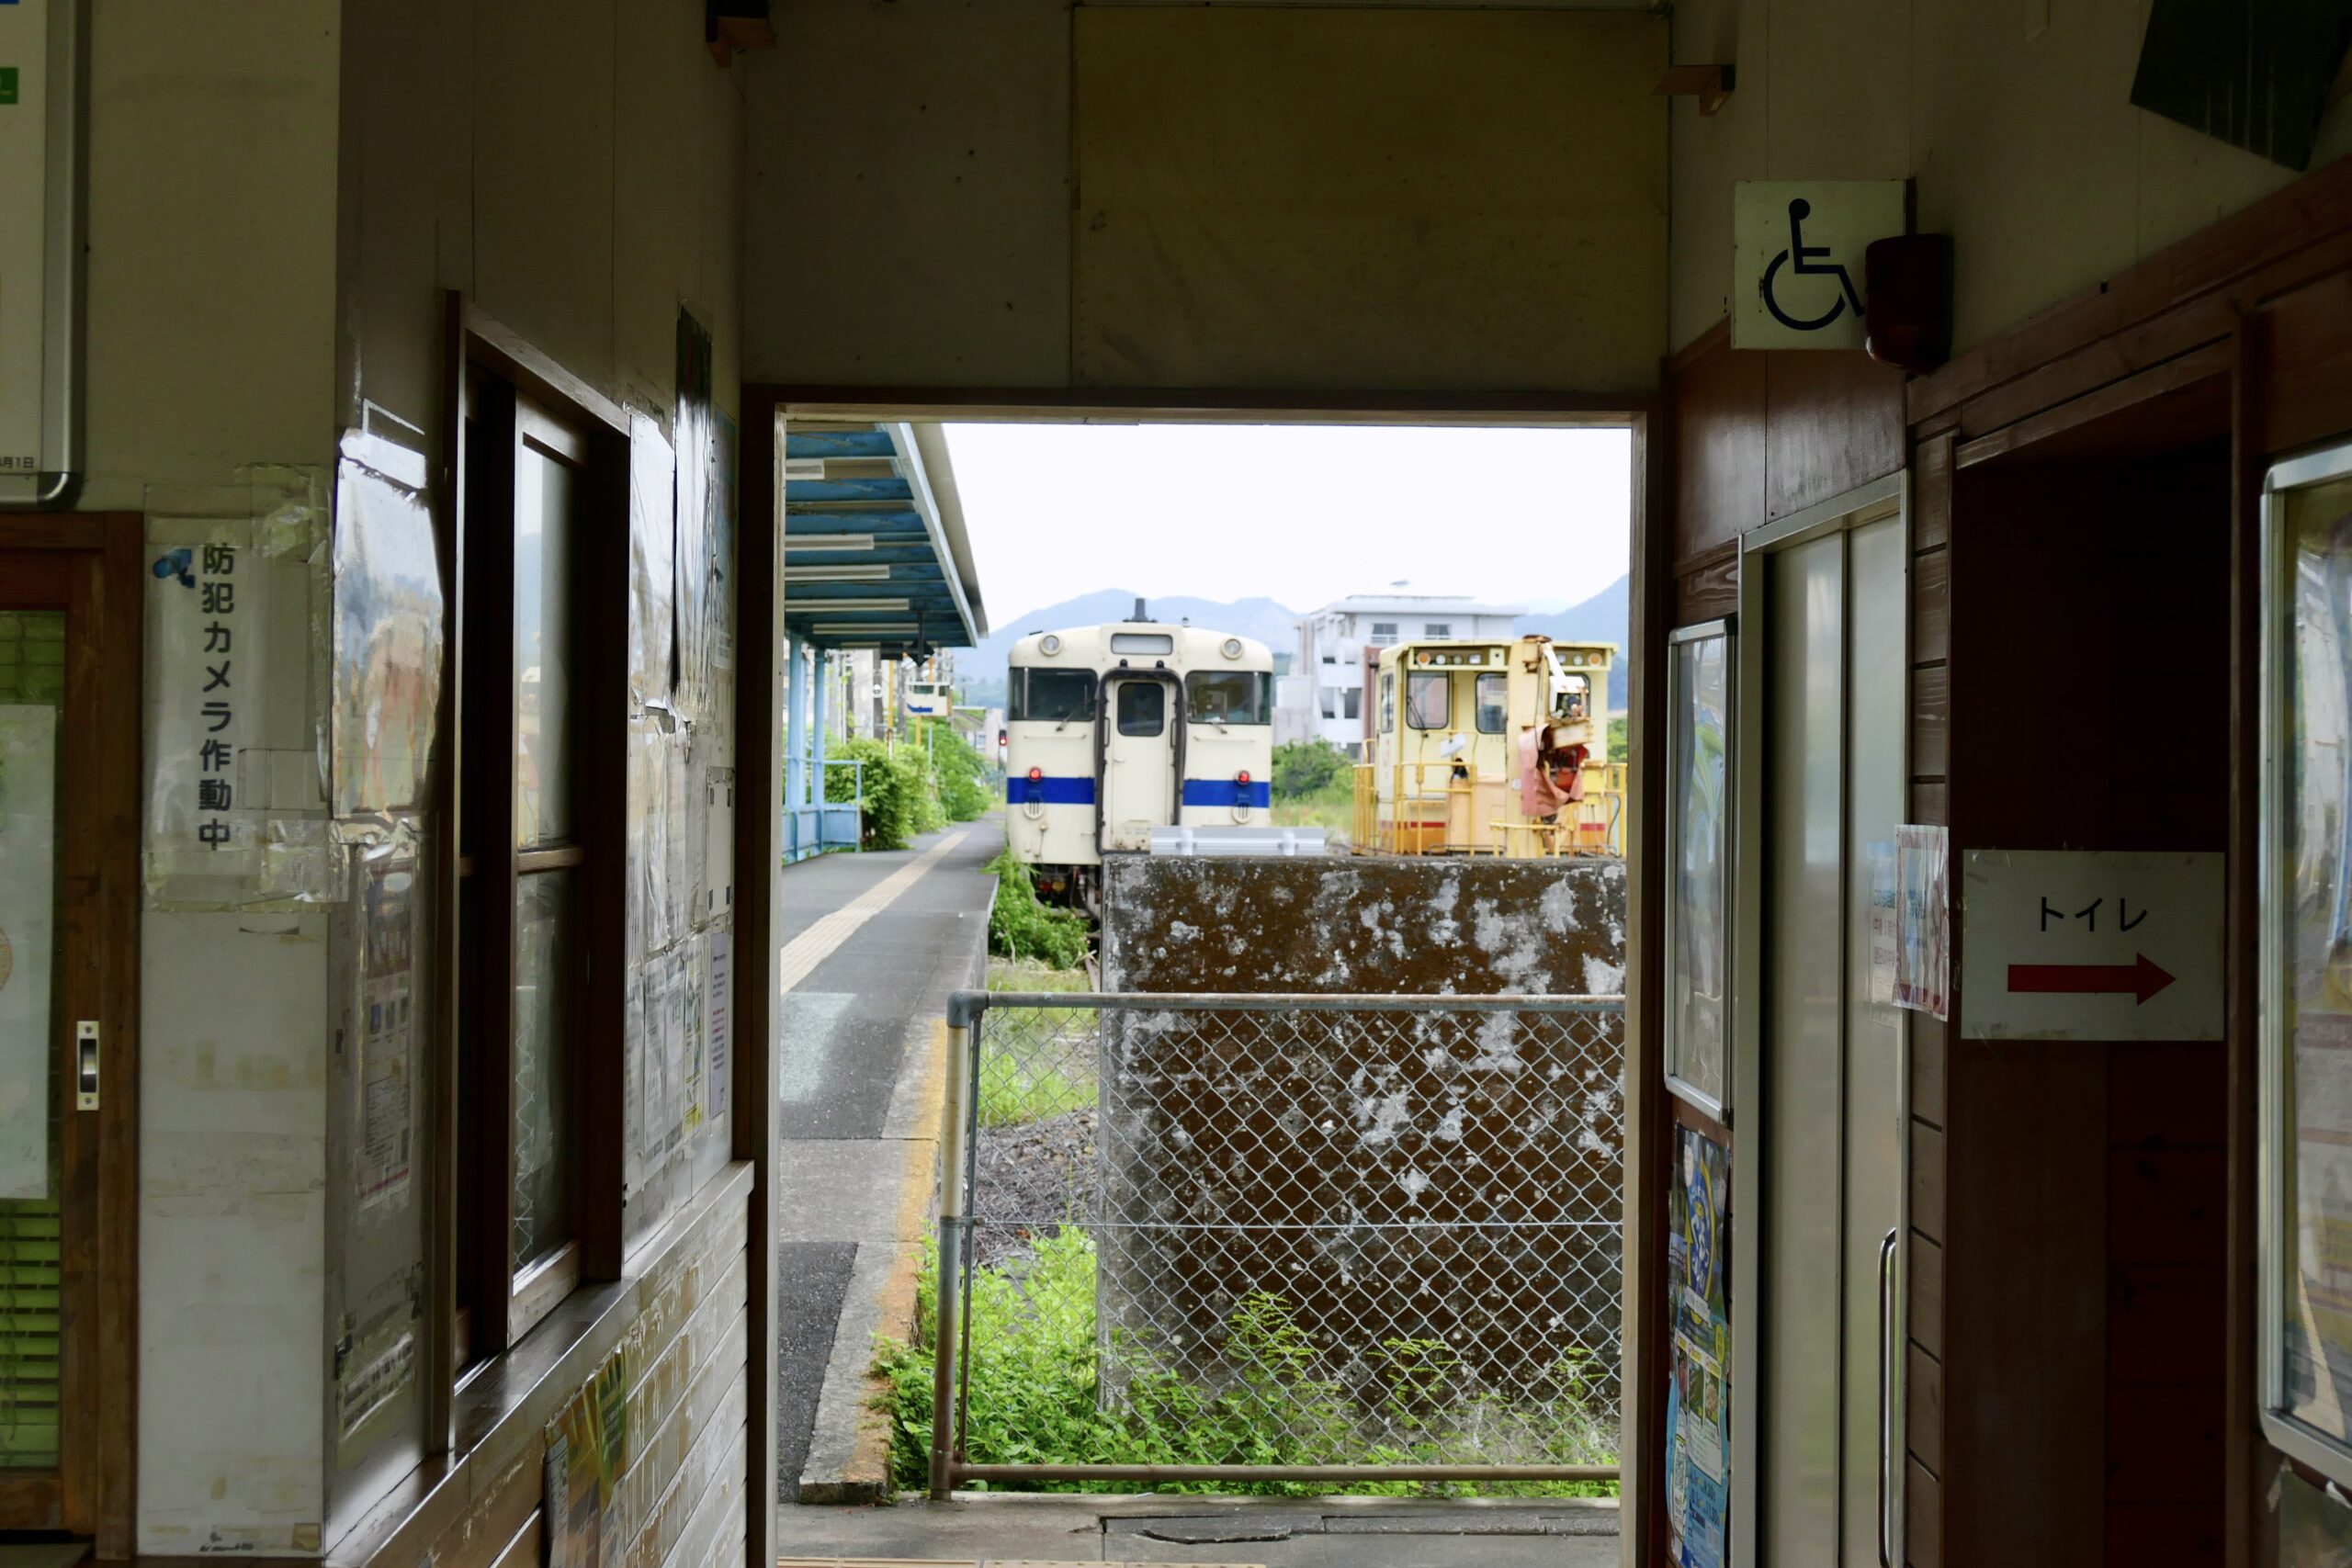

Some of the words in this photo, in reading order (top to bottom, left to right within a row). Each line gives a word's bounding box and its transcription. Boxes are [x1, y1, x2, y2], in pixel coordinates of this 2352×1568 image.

[0, 457, 34, 468] 月1日
[198, 544, 235, 851] 防犯カメラ作動中
[2041, 897, 2147, 931] トイレ
